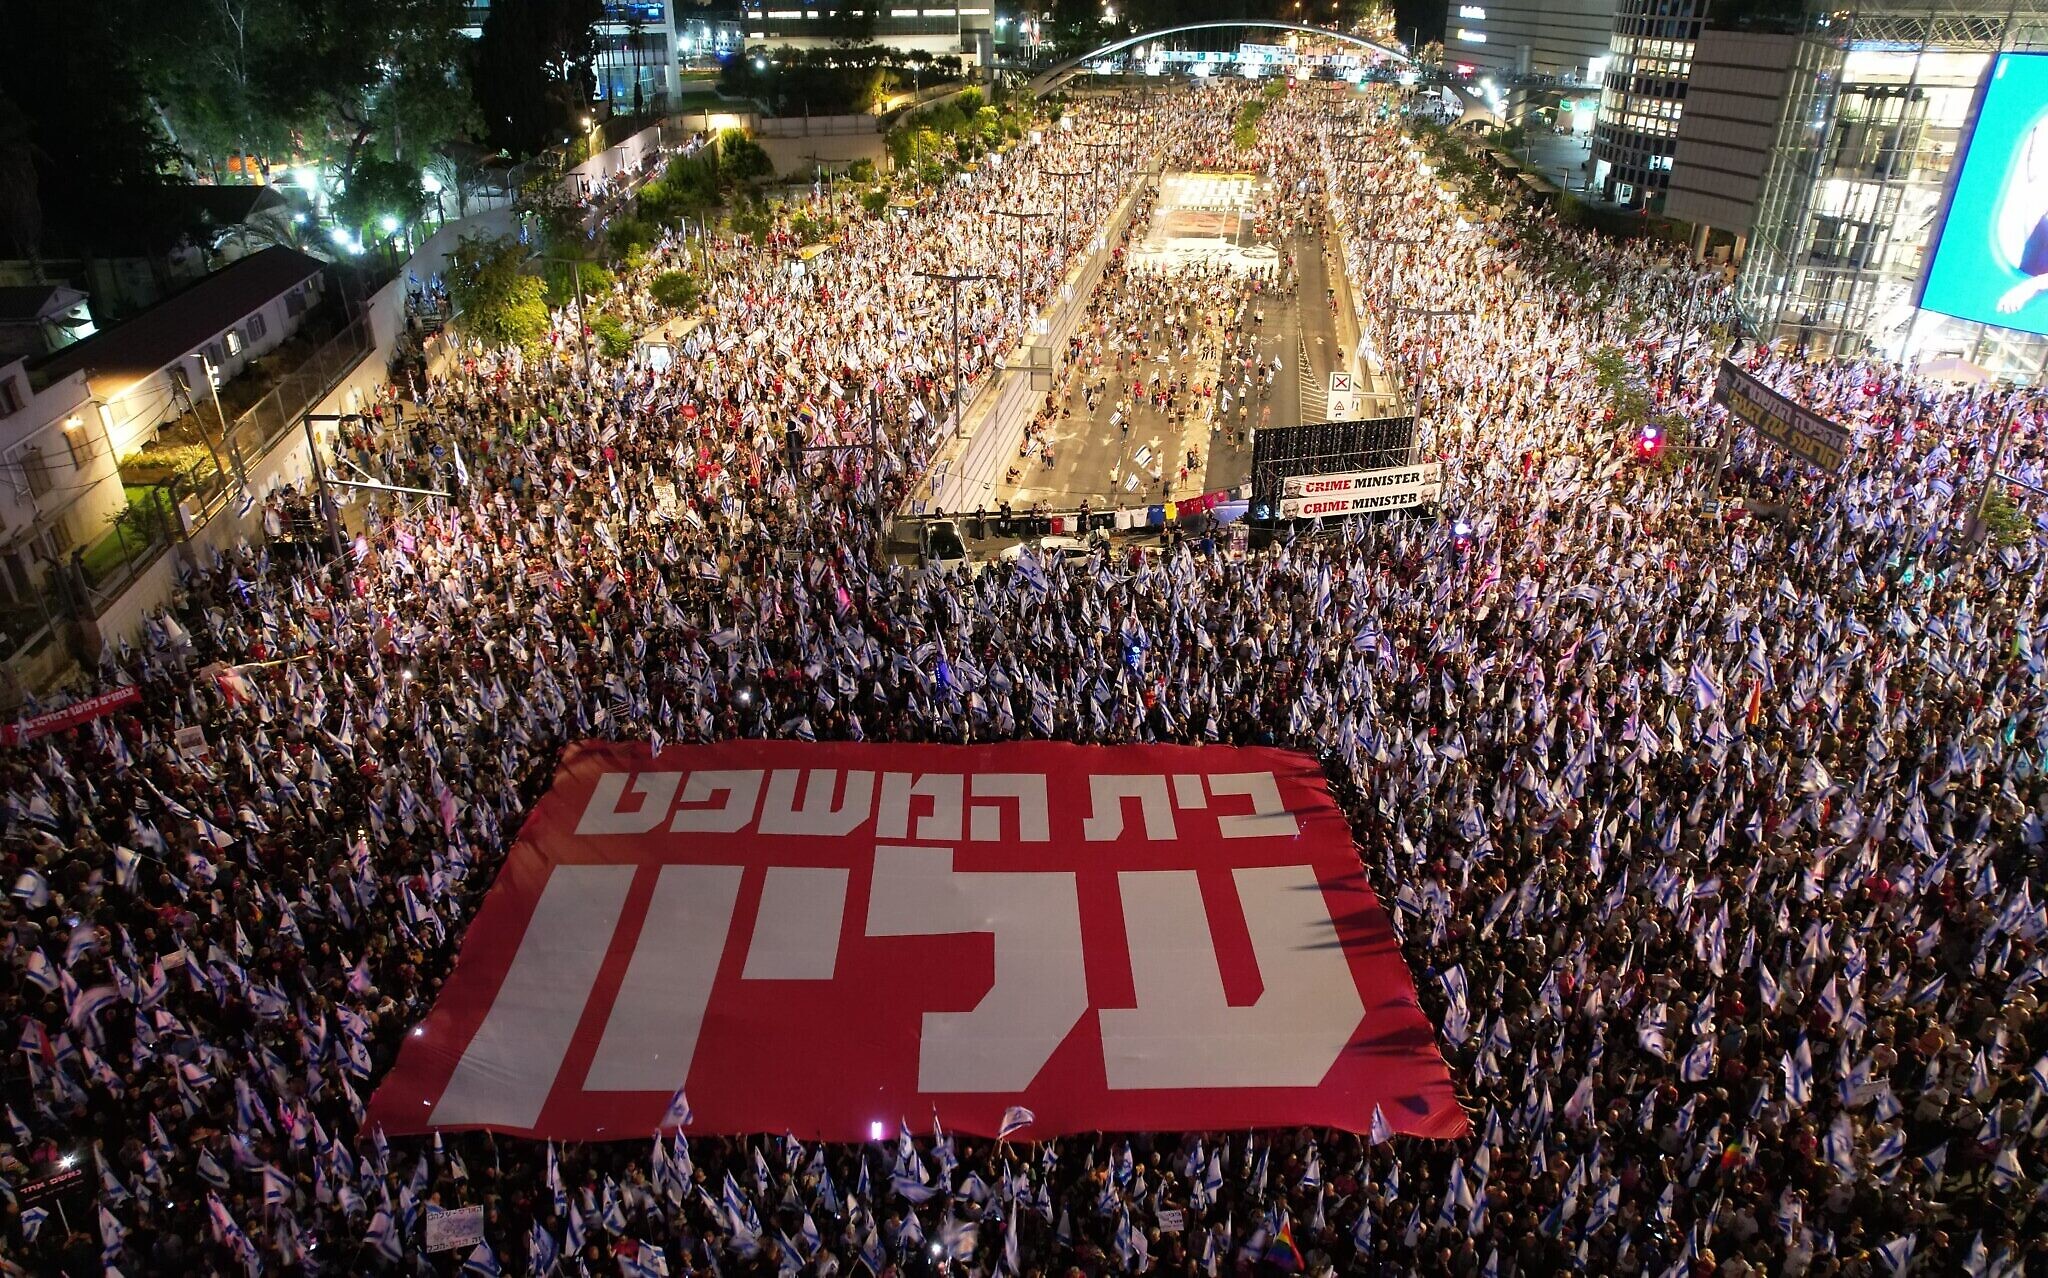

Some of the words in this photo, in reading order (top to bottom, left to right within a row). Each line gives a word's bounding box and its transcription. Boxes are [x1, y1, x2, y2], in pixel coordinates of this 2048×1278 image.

[1303, 500, 1349, 514] CRIME
[1351, 493, 1417, 509] MINISTER
[1305, 480, 1352, 493] CRIME
[1354, 472, 1420, 489] MINISTER
[574, 769, 1050, 841] המשפט
[1082, 771, 1301, 842] בית
[431, 846, 1365, 1127] עליון
